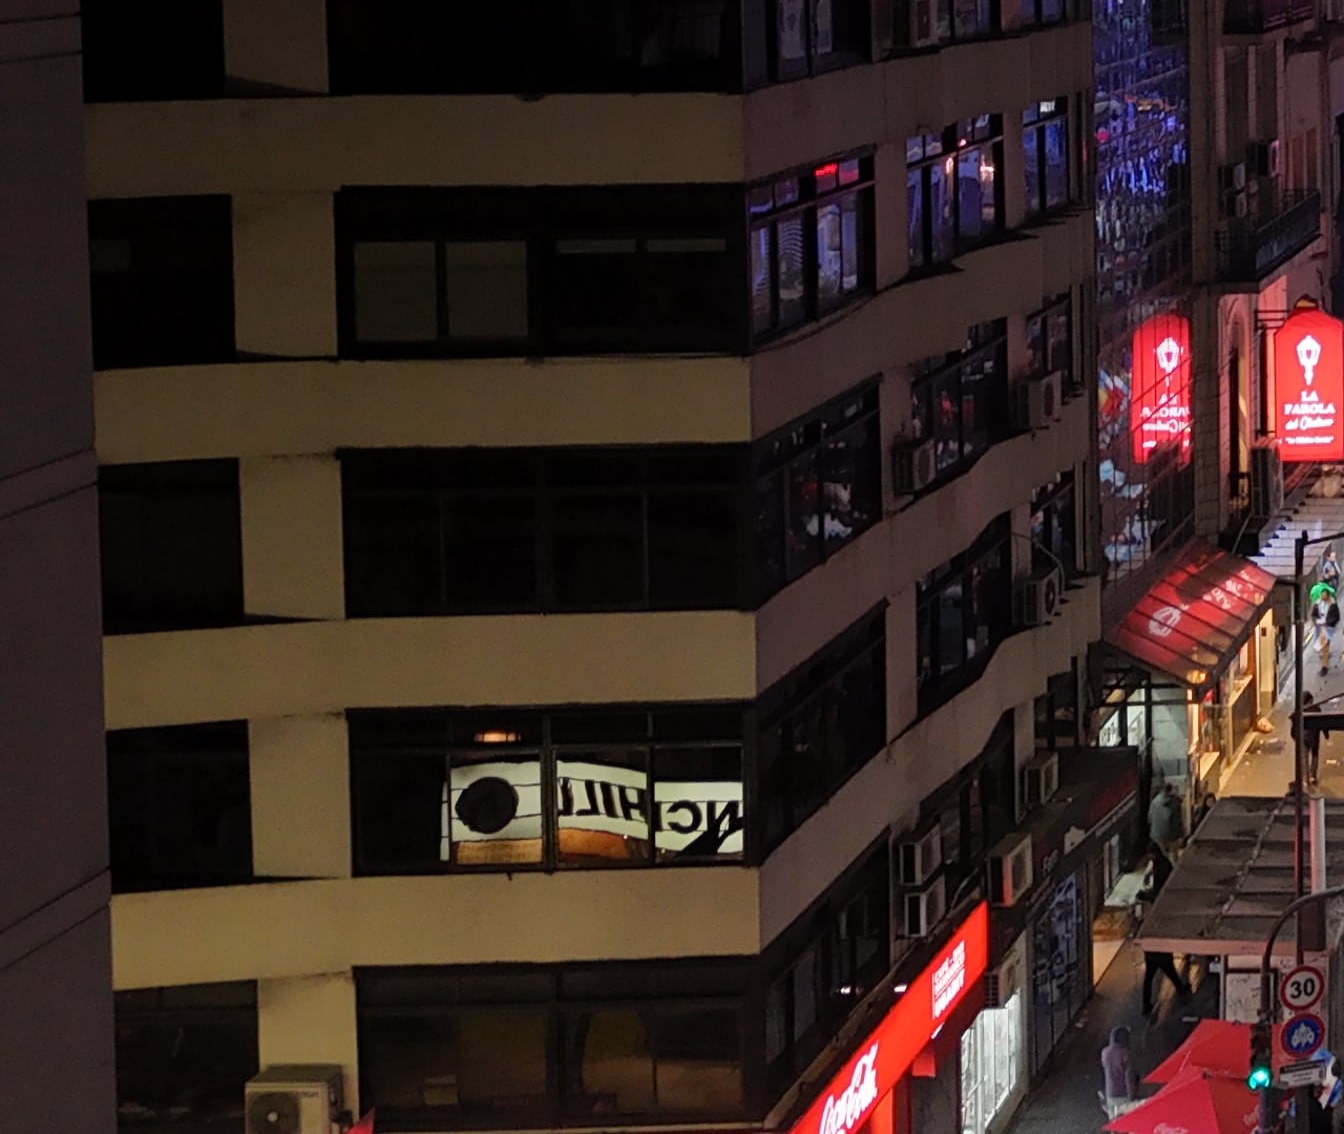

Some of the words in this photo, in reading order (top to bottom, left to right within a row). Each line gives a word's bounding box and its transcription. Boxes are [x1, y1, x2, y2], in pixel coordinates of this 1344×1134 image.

[1301, 391, 1319, 401] LA
[1284, 403, 1336, 415] FAROLA
[1290, 978, 1316, 999] 30
